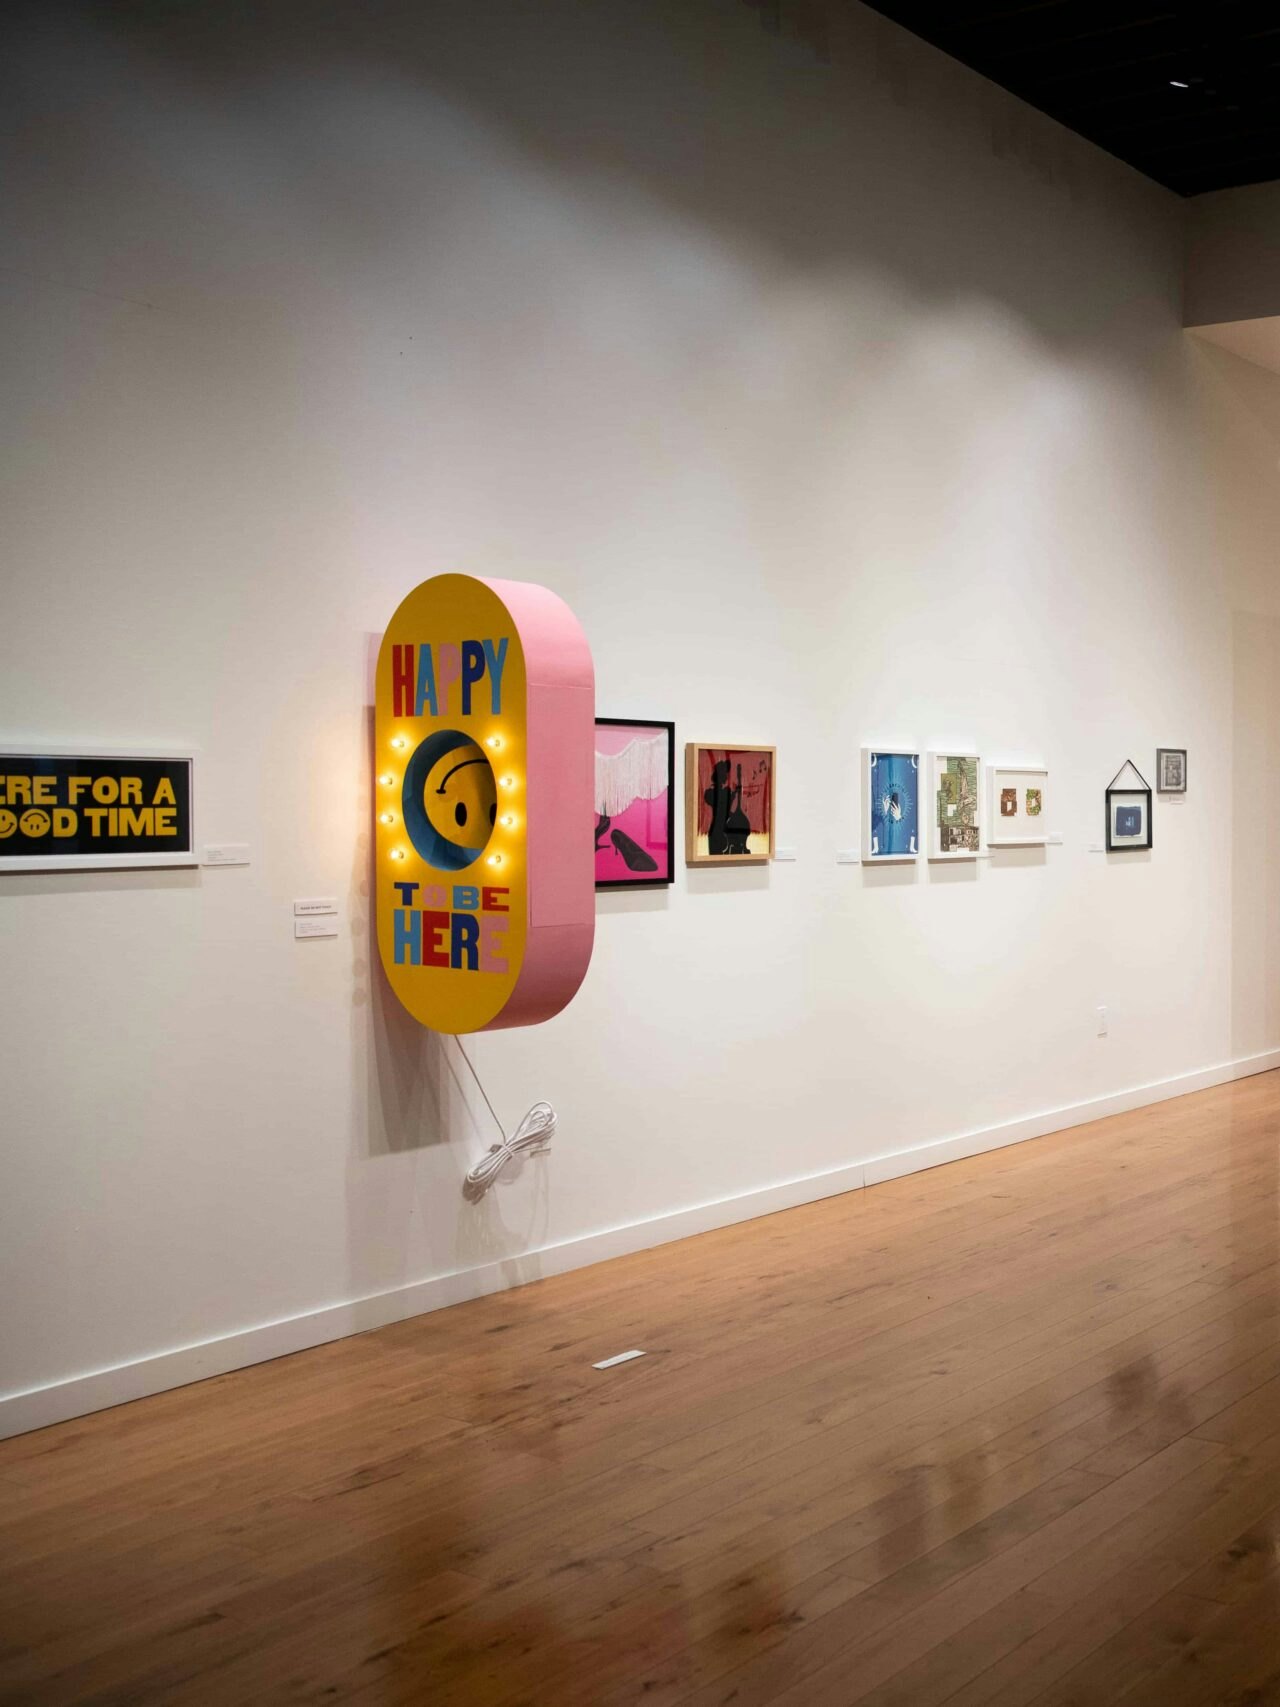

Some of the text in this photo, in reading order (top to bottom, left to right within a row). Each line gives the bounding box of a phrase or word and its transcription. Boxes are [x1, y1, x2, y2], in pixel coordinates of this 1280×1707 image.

[392, 637, 509, 718] HAPPY
[0, 775, 176, 805] RE FOR A
[84, 807, 177, 837] TIME
[394, 882, 509, 912] TO BE
[394, 909, 509, 975] HERE
